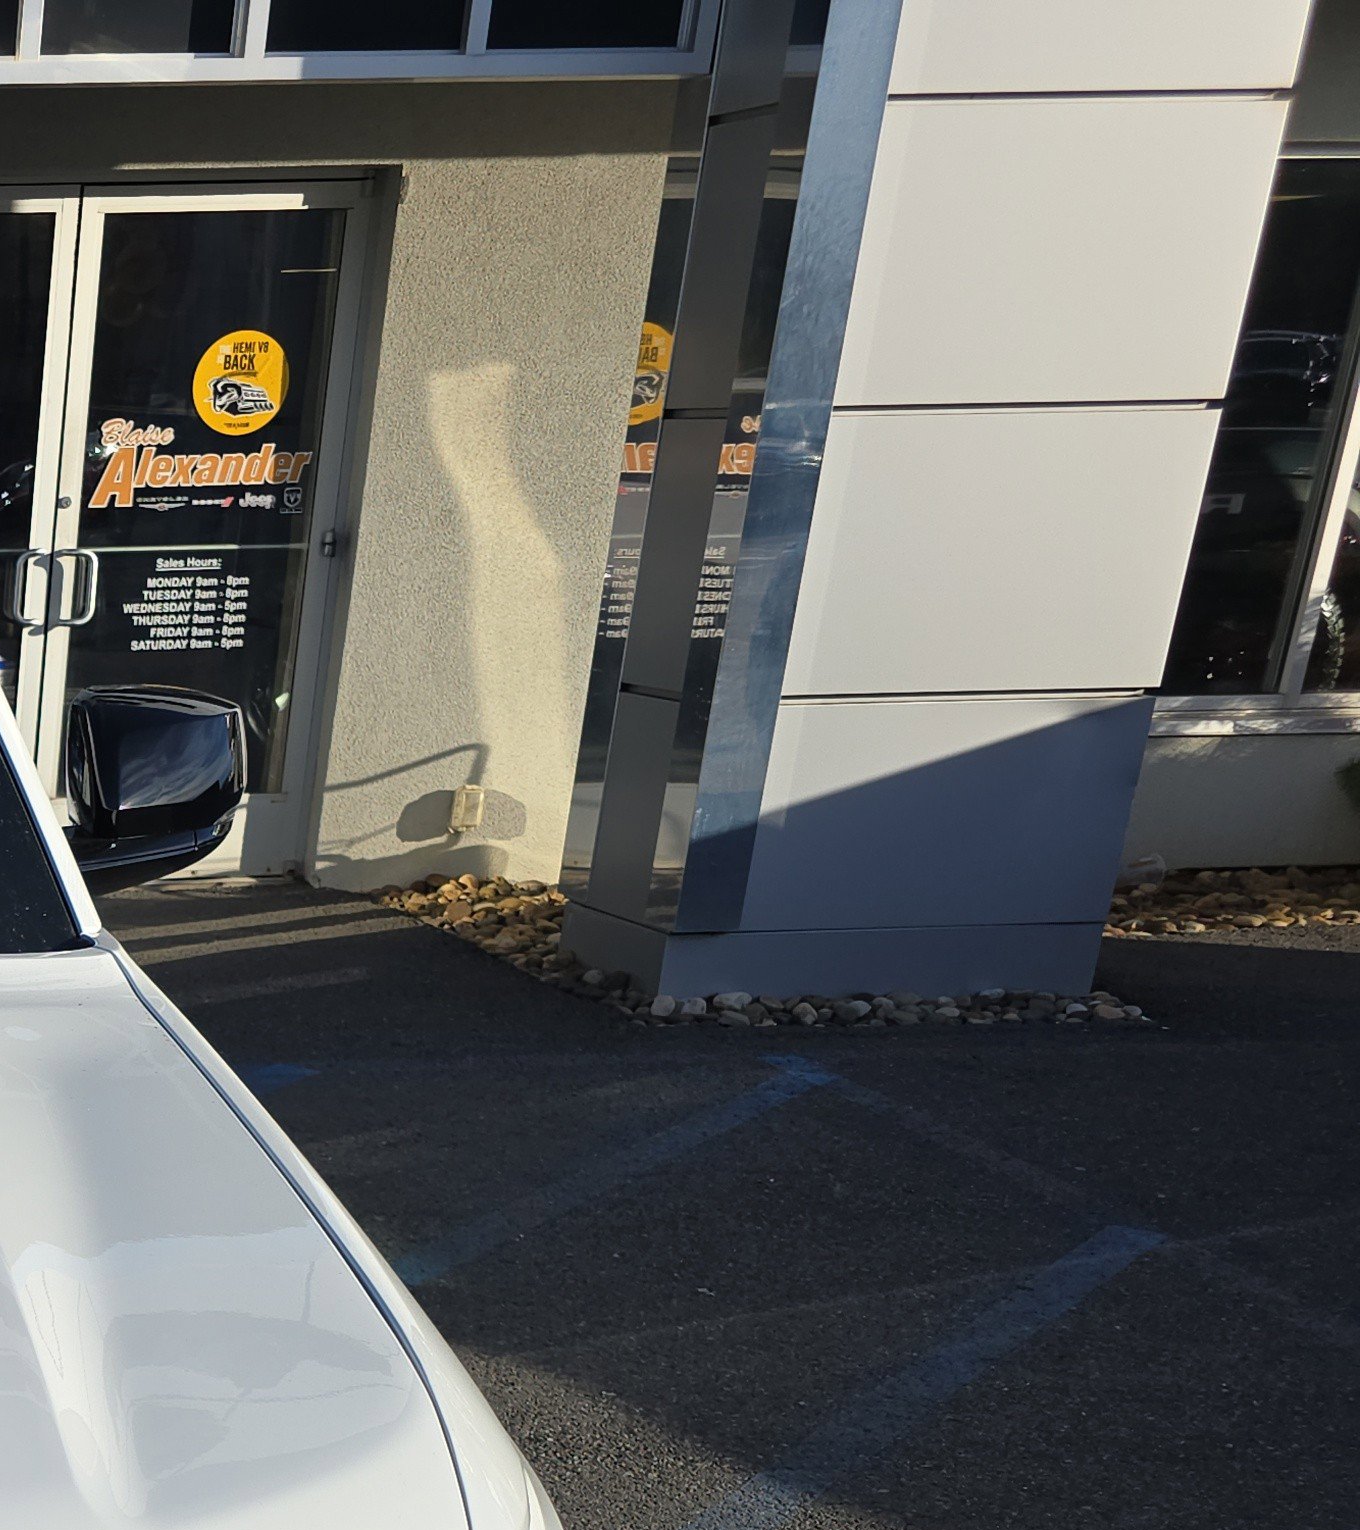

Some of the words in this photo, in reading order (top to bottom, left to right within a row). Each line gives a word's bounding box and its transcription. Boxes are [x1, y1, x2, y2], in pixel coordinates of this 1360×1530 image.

[233, 342, 255, 353] HEMI
[258, 341, 269, 353] V8
[224, 354, 256, 370] BACK
[101, 418, 175, 446] Blaise
[88, 443, 313, 509] Alexander
[239, 492, 276, 510] Jeep
[156, 558, 185, 570] Sales
[187, 557, 222, 568] Hours:
[147, 576, 194, 588] MONDAY
[196, 576, 218, 587] 9am
[143, 589, 193, 601] TUESDAY
[194, 589, 217, 599] 9am
[123, 602, 192, 614] WEDNESDAY
[194, 602, 216, 611] 9am
[132, 614, 191, 626] THURSDAY
[192, 614, 215, 624] 9am
[150, 627, 190, 638] FRIDAY
[191, 626, 213, 637] 9am
[131, 639, 188, 651] SATURDAY
[190, 639, 212, 649] 9am
